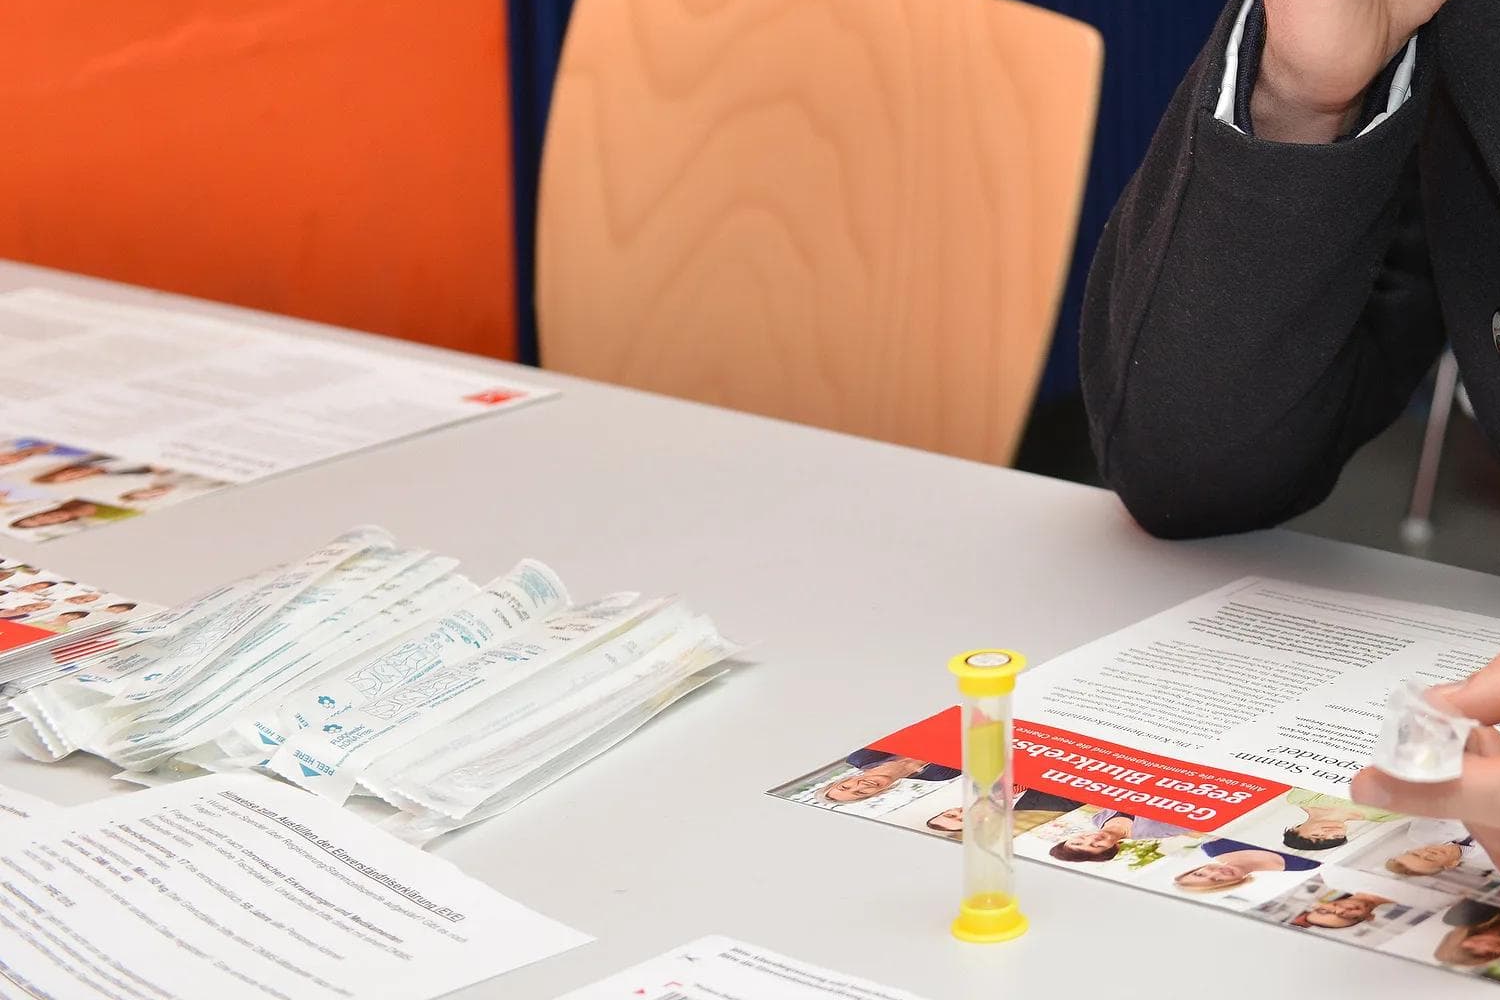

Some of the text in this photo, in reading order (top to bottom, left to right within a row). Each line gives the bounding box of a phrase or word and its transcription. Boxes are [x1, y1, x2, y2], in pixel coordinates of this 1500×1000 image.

[1015, 727, 1050, 740] Chance
[1051, 736, 1075, 744] neue
[1090, 746, 1112, 754] und
[294, 749, 336, 776] PEEL HERE
[1112, 752, 1197, 776] Stammzellspende
[1230, 752, 1309, 773] Stamm-
[1042, 769, 1215, 820] Gemeinsam
[1155, 777, 1251, 803] gegen
[1239, 782, 1266, 791] Alles
[241, 849, 285, 878] chronischen
[284, 876, 335, 907] Erkrankungen
[276, 816, 318, 839] Ausfüllen
[316, 839, 334, 849] der
[332, 848, 436, 908] Einverständniserklärung
[432, 907, 465, 922] (EVE)
